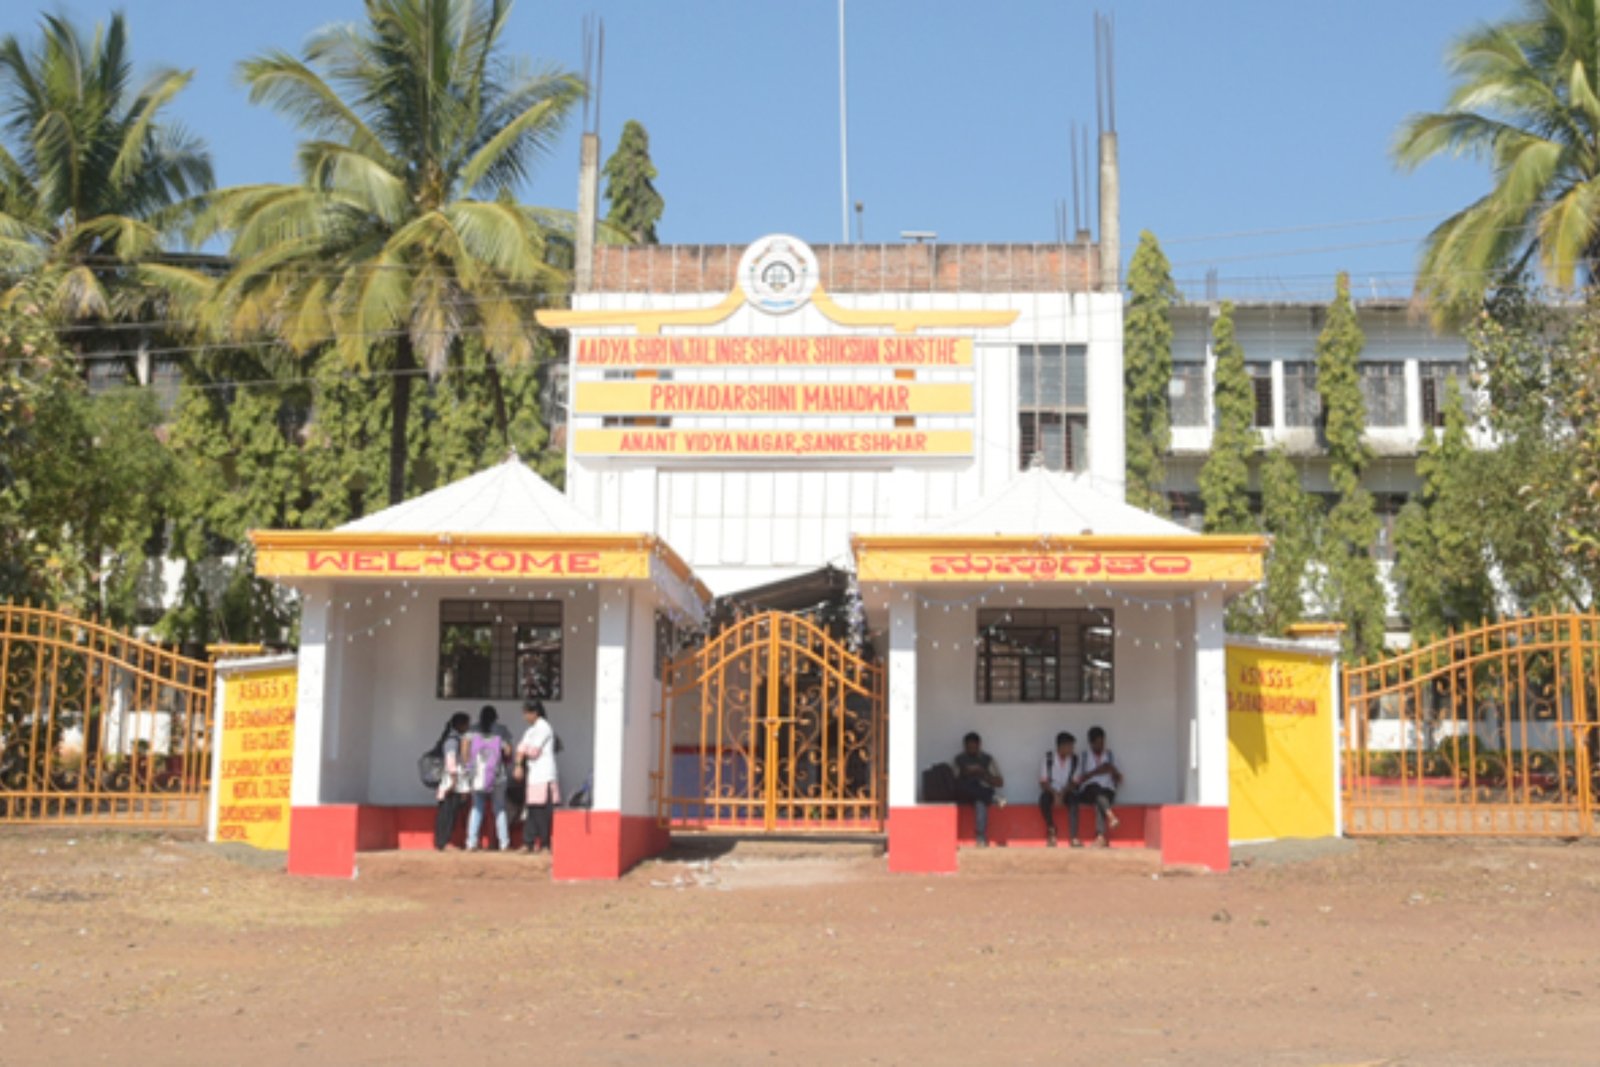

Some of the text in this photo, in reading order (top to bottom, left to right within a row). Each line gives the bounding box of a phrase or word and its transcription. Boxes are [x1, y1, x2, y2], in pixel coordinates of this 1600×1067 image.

[576, 336, 631, 364] AADYA
[883, 337, 959, 364] SANSTHE
[651, 384, 910, 411] PRIYADARSHINI MAHADWAR
[620, 431, 678, 451] ANANT
[307, 550, 600, 573] WEL-COME
